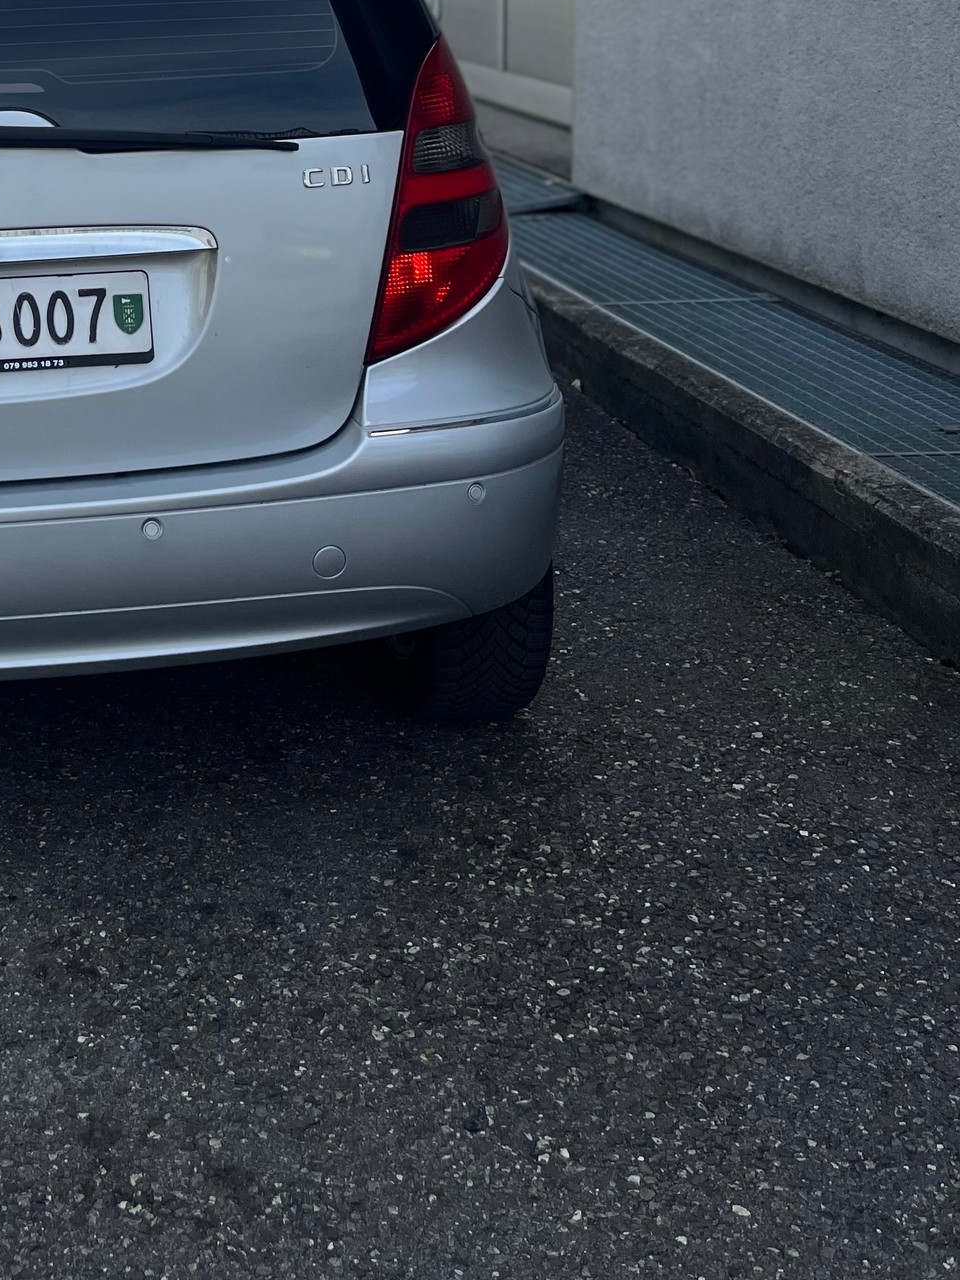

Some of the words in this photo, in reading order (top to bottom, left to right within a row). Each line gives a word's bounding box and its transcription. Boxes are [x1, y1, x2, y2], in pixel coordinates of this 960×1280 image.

[302, 164, 371, 188] CDI
[3, 361, 20, 370] 079
[22, 360, 38, 368] 953
[41, 359, 51, 367] 18
[53, 359, 64, 367] 73
